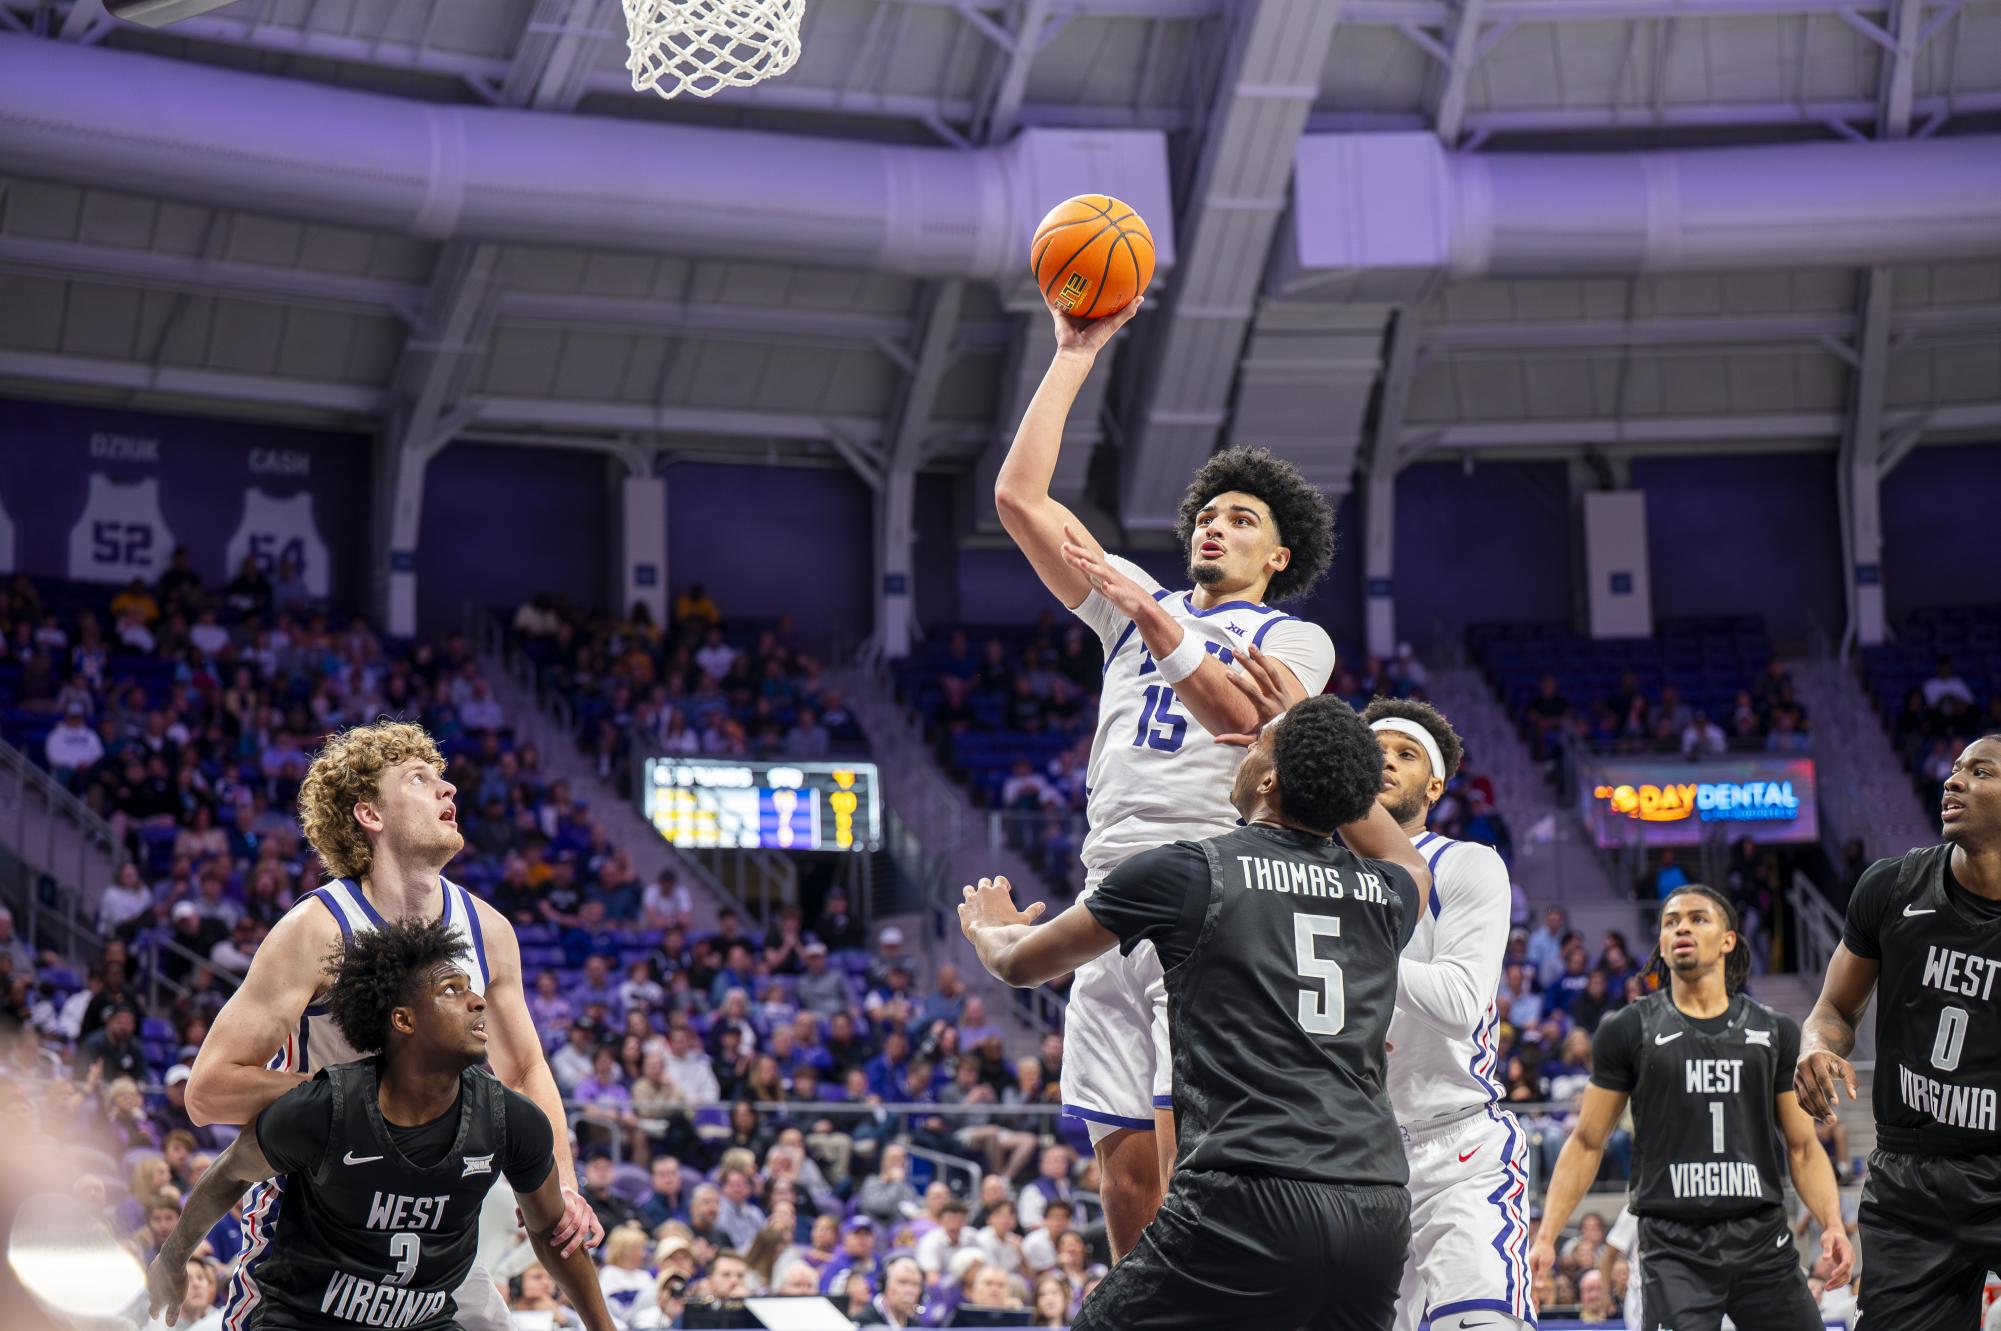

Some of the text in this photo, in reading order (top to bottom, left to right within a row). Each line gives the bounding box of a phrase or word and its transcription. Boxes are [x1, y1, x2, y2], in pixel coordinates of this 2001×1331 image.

[249, 448, 311, 476] CASH
[93, 520, 153, 566] 52
[1132, 685, 1188, 752] 15
[1638, 781, 1799, 814] DAY DENTAL
[1237, 856, 1388, 905] THOMAS JR.
[1293, 912, 1345, 1036] 5
[1922, 945, 2001, 1001] WEST
[1930, 1005, 1969, 1072] 0
[1686, 1059, 1744, 1093] WEST
[1899, 1064, 1997, 1131] VIRGINIA
[1709, 1101, 1725, 1153] 1
[1670, 1162, 1763, 1198] VIRGINIA
[366, 1191, 450, 1231] WEST
[380, 1232, 421, 1287] 3
[321, 1269, 446, 1329] VIRGINIA
